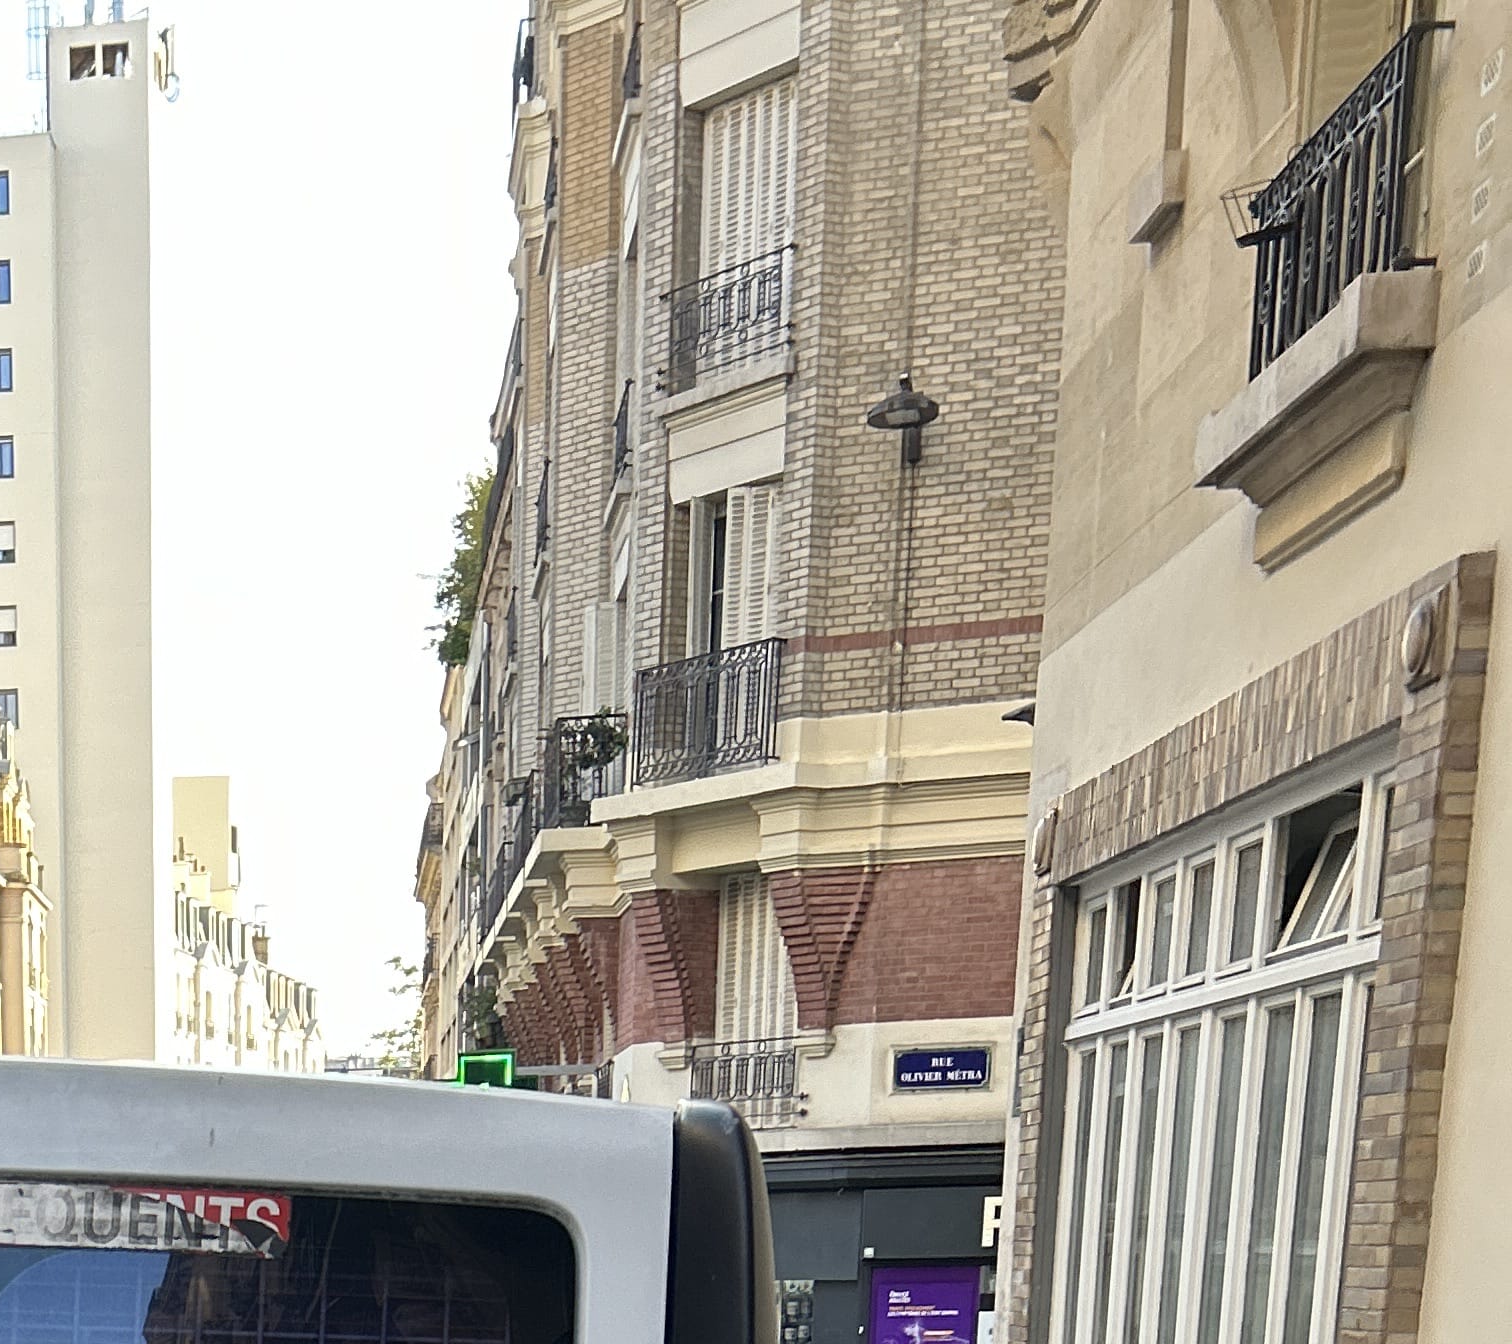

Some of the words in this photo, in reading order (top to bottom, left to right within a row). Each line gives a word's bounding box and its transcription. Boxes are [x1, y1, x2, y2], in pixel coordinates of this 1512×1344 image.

[931, 1057, 954, 1067] RUE
[900, 1071, 942, 1082] OLIVIER
[946, 1069, 982, 1081] MÉTRA
